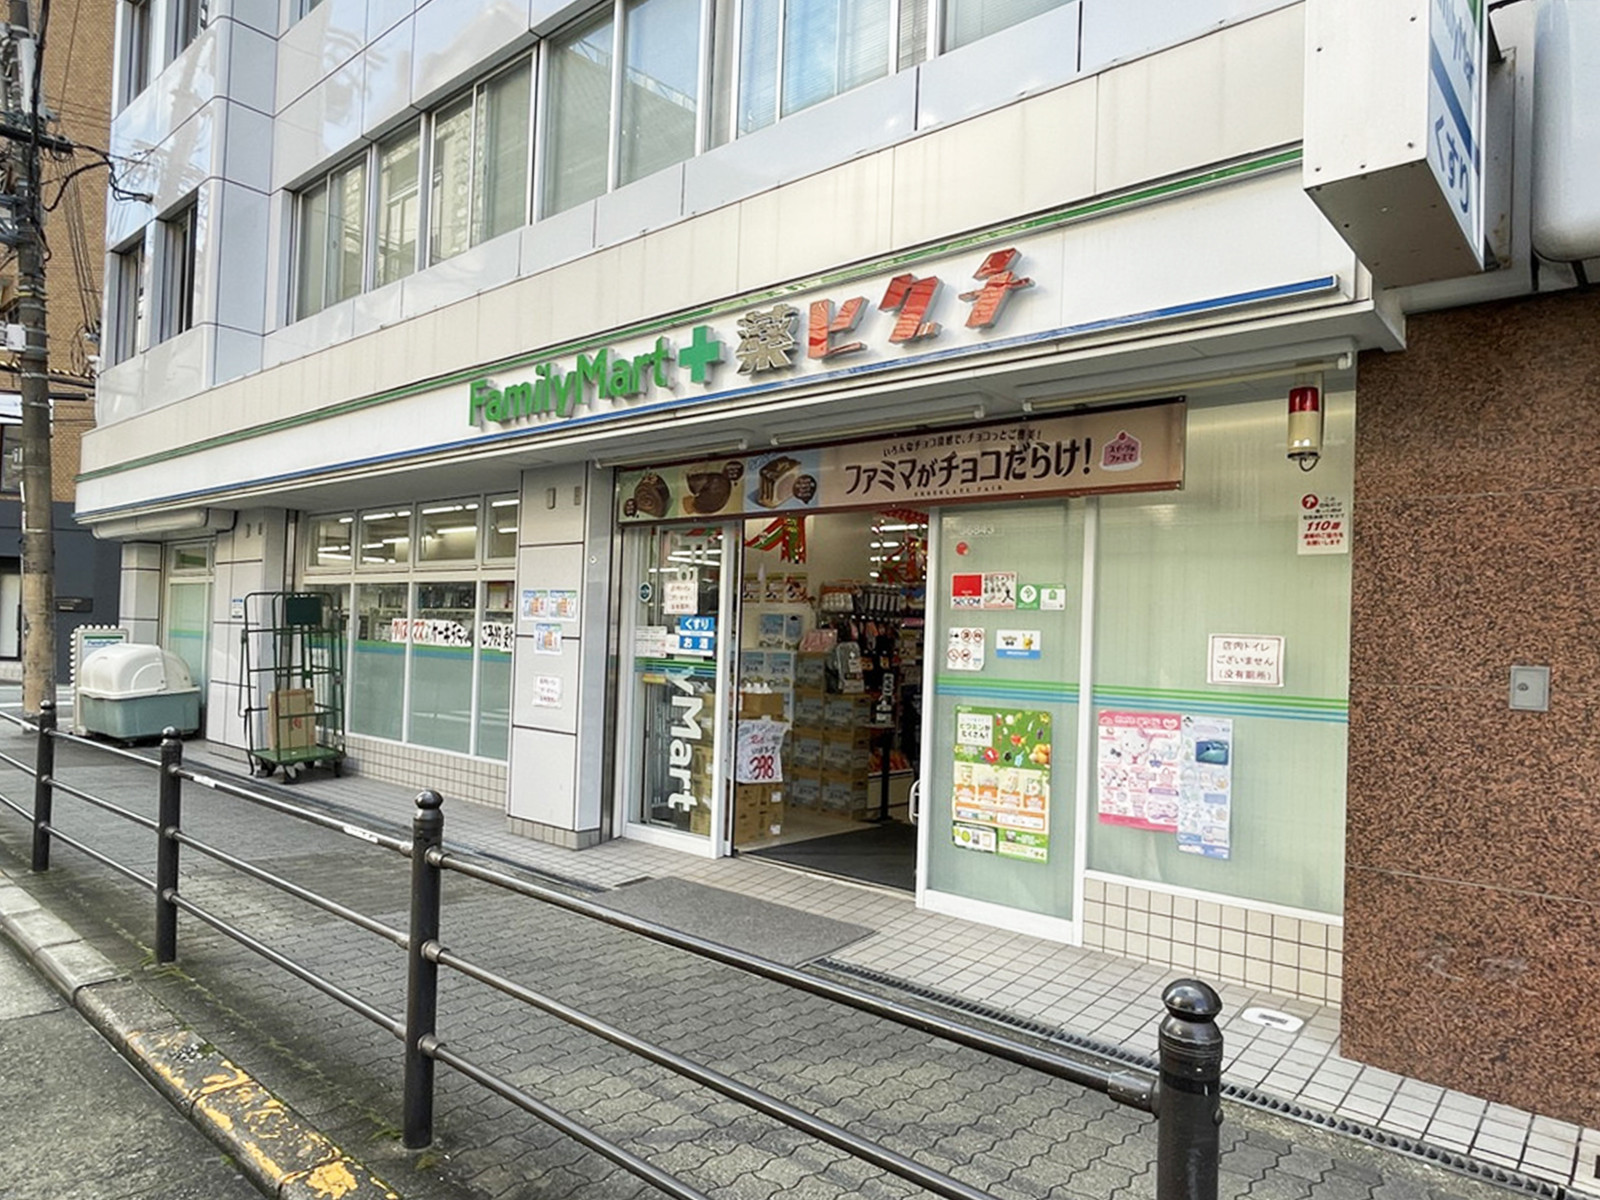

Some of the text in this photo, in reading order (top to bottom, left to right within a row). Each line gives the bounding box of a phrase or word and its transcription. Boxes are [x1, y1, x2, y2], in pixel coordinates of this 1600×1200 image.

[1435, 115, 1469, 213] くすり
[469, 335, 673, 428] FamilyMart
[1307, 520, 1341, 532] 110番
[685, 617, 709, 630] くすり
[1222, 640, 1270, 652] 店内トイレ
[1216, 654, 1274, 667] ございません
